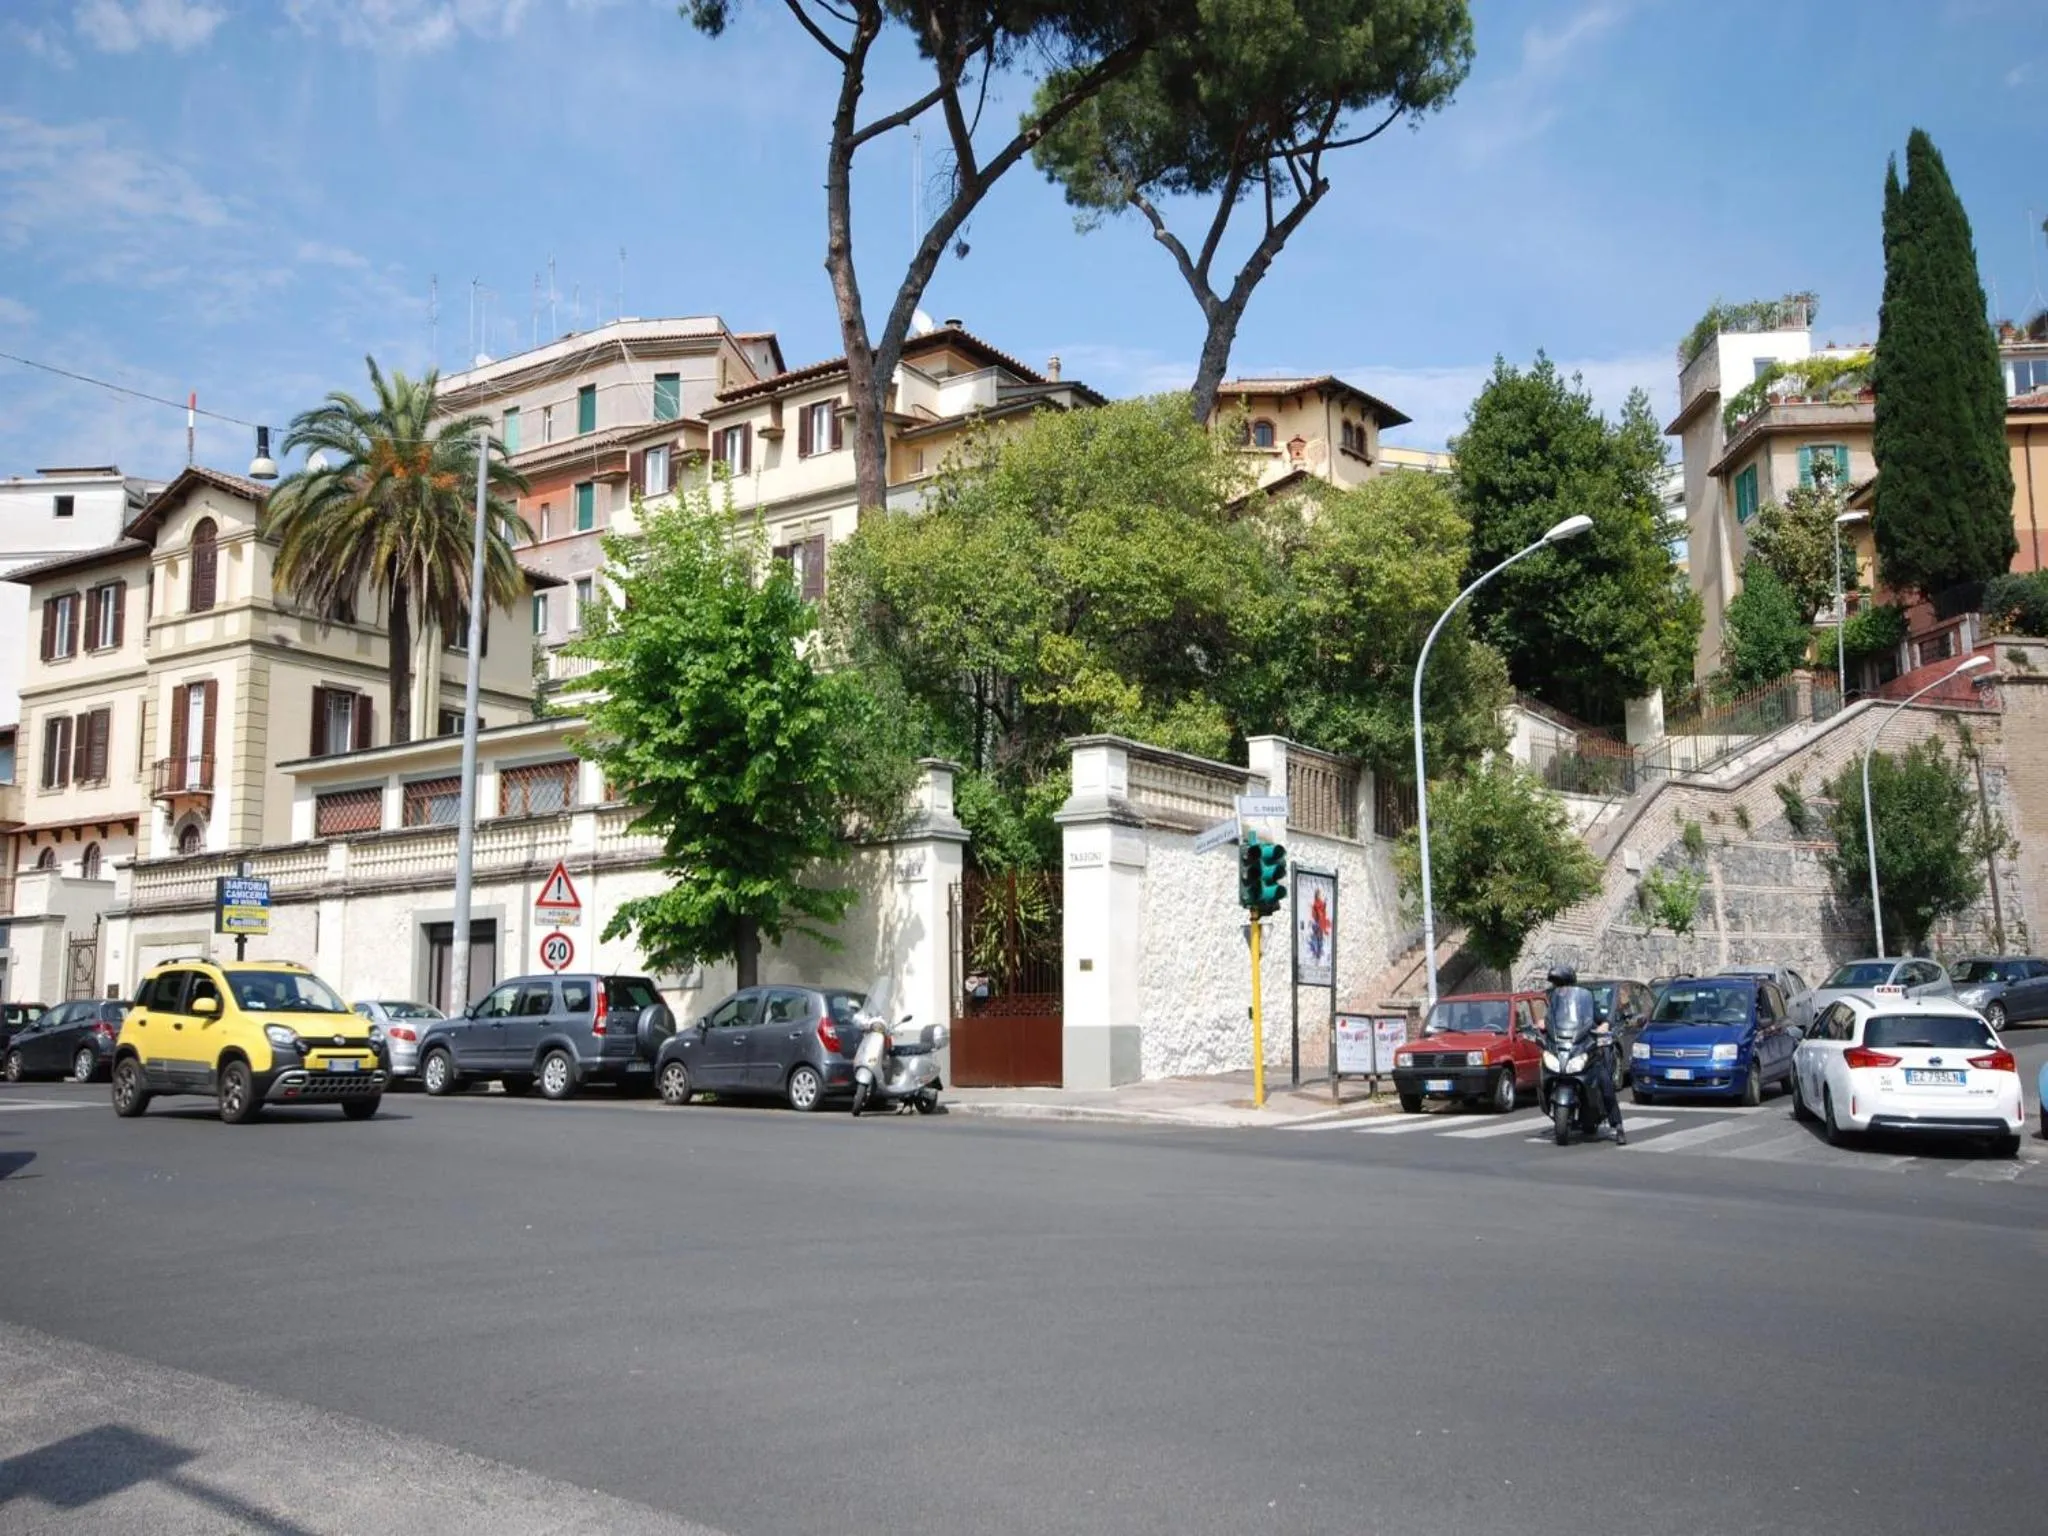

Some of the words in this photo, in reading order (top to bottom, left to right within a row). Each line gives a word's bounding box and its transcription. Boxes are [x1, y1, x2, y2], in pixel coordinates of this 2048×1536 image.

[225, 881, 267, 891] SARTORIA
[226, 890, 267, 899] CAMICERIA
[548, 942, 567, 960] 20
